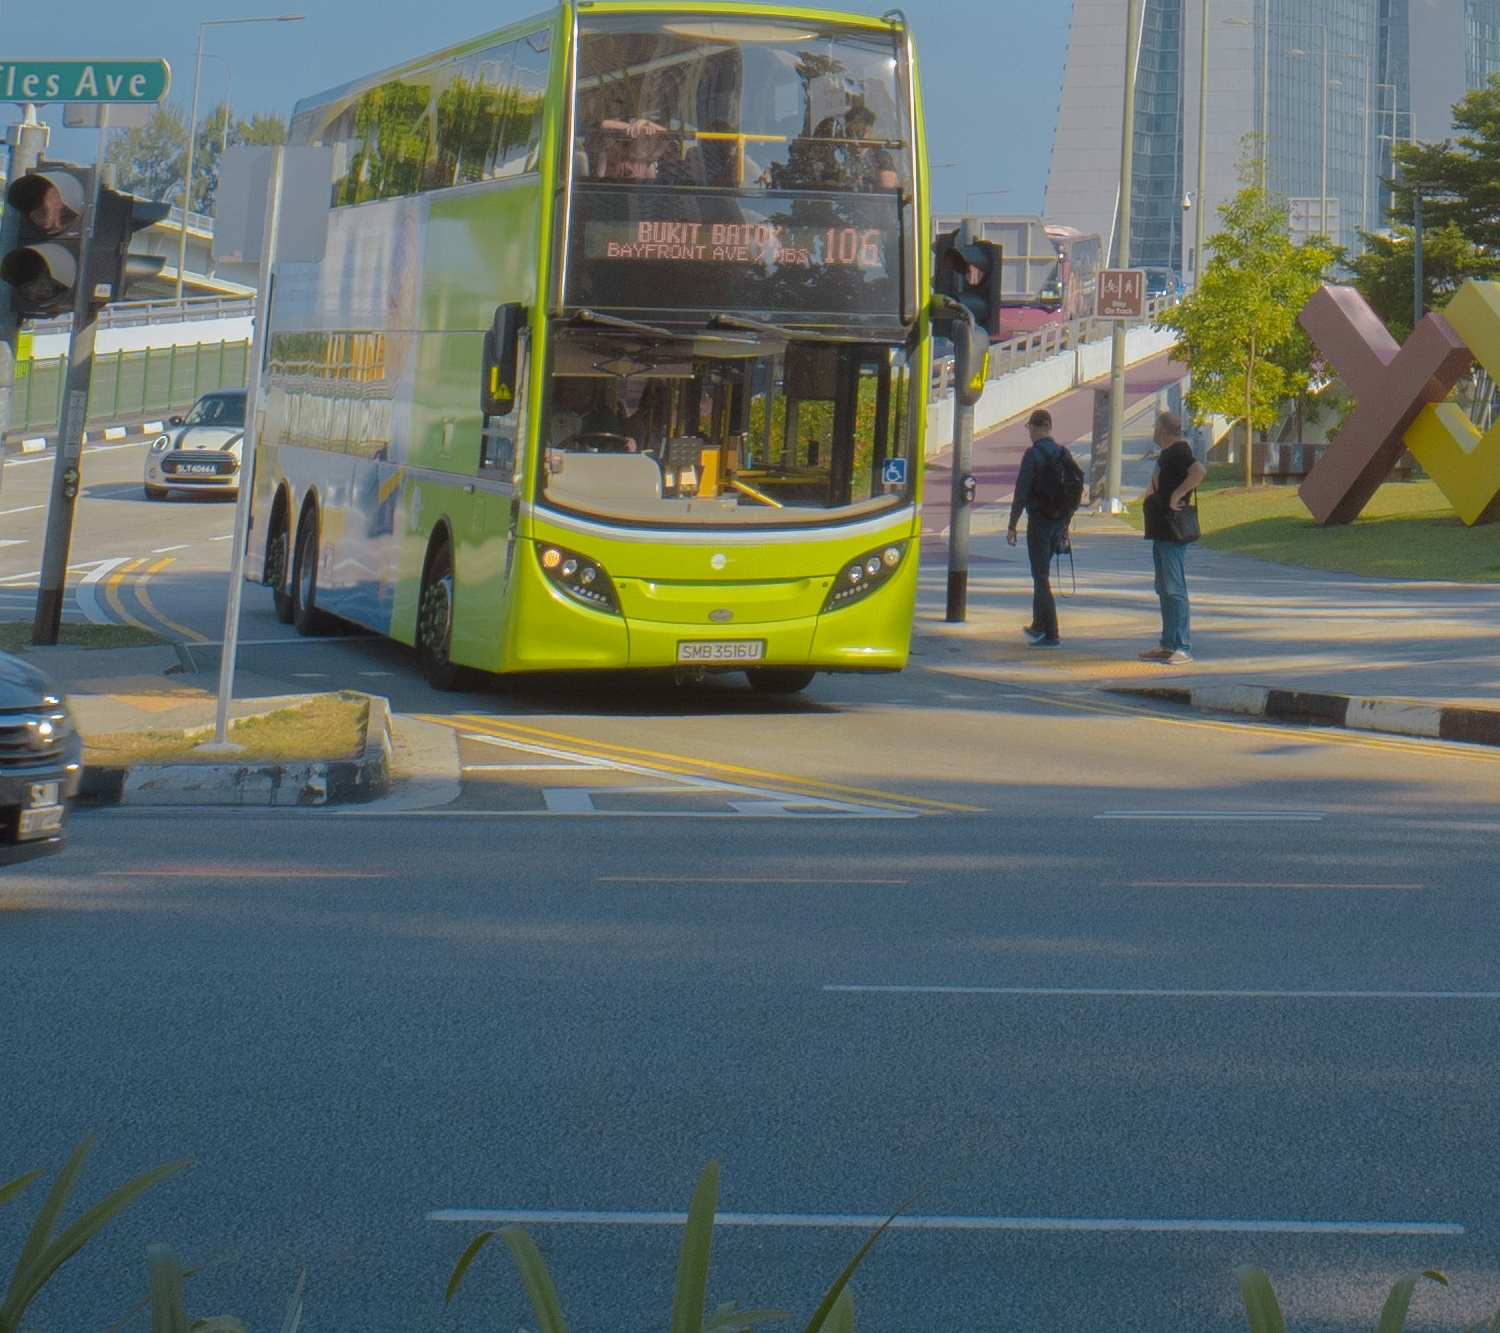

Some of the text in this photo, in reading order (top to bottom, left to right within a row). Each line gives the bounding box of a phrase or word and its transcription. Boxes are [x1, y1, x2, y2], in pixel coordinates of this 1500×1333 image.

[75, 65, 147, 98] Ave
[638, 221, 783, 248] BUKIT BATOK
[607, 242, 707, 260] BAYFRONT
[713, 246, 749, 261] AVE
[773, 247, 809, 263] MBS
[825, 228, 880, 265] 106
[1112, 300, 1127, 308] Stay
[1116, 307, 1133, 315] Track
[682, 643, 758, 659] SMB3516U
